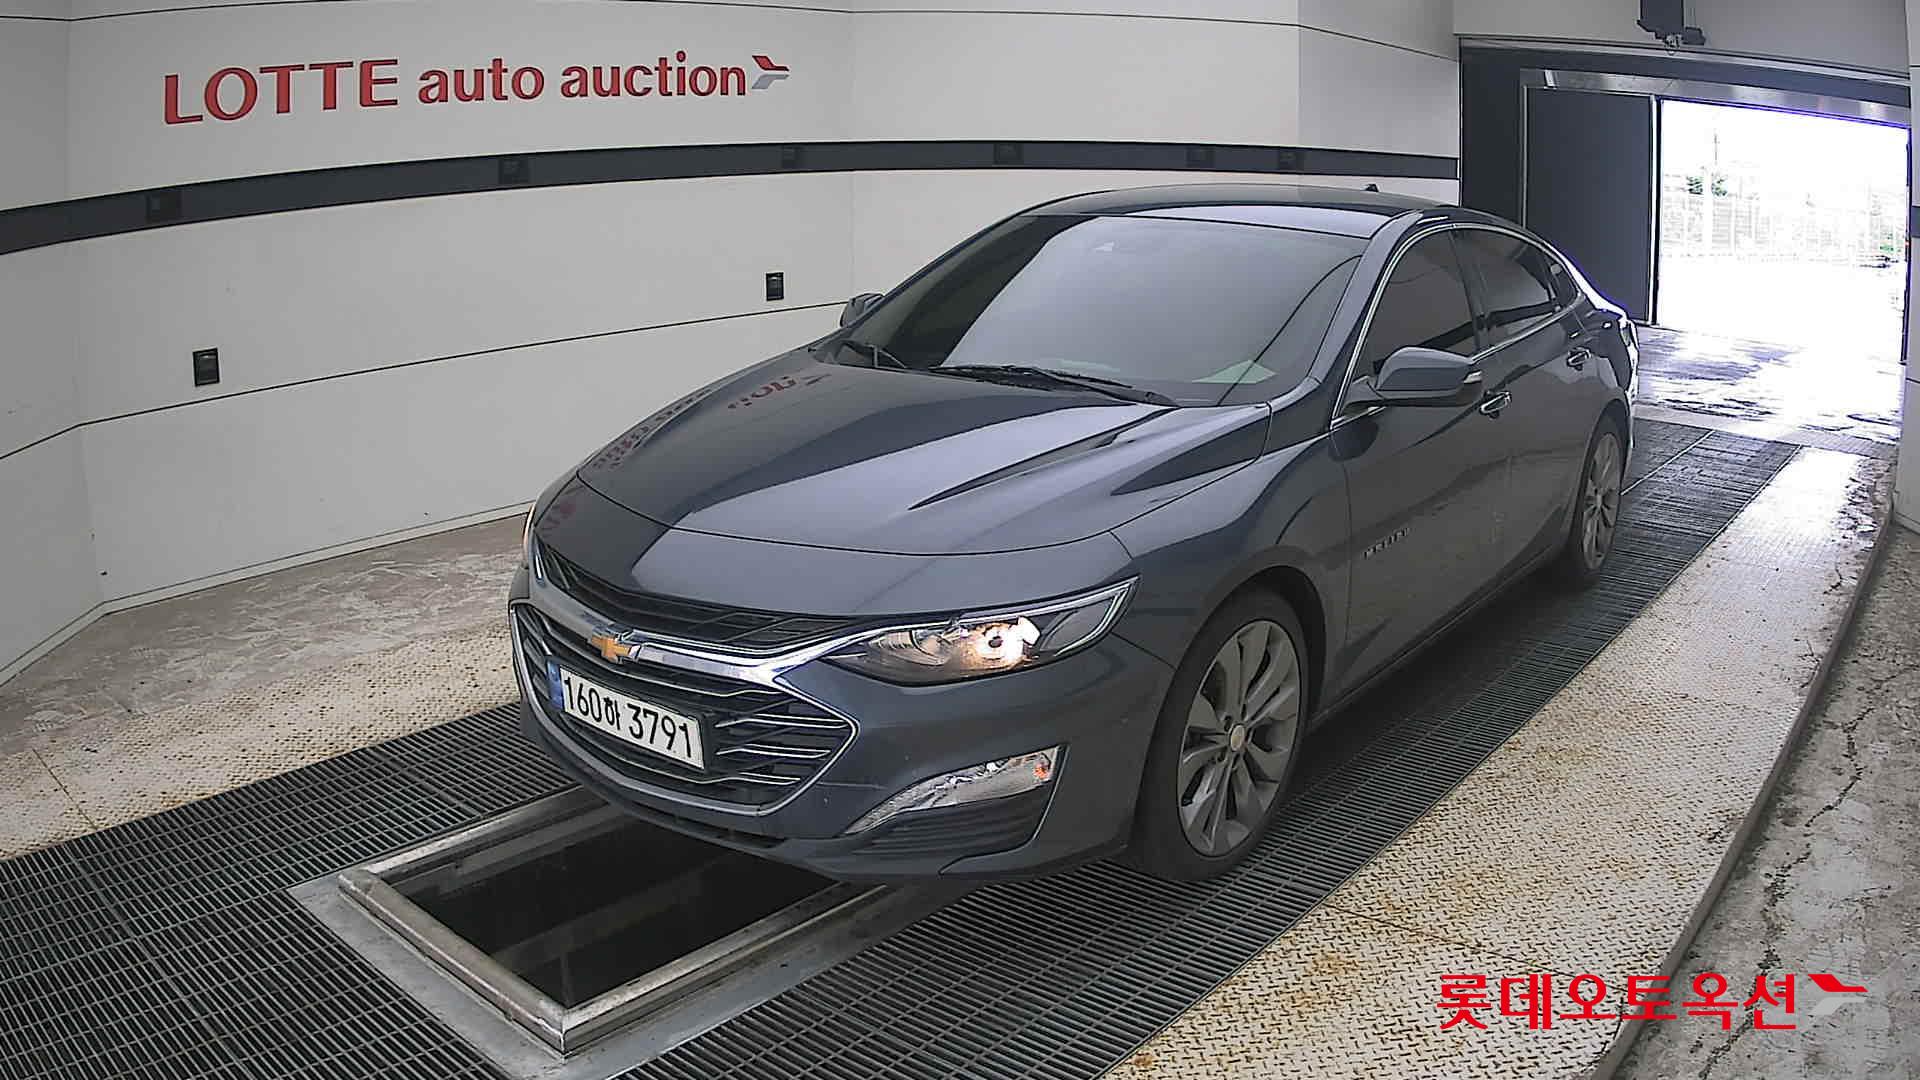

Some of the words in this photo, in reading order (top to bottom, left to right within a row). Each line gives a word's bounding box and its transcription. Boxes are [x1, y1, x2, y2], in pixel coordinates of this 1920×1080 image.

[164, 59, 399, 125] LOTTE
[418, 58, 545, 104] auto
[560, 51, 747, 97] auction
[564, 677, 621, 731] 160하
[626, 702, 692, 758] 3791
